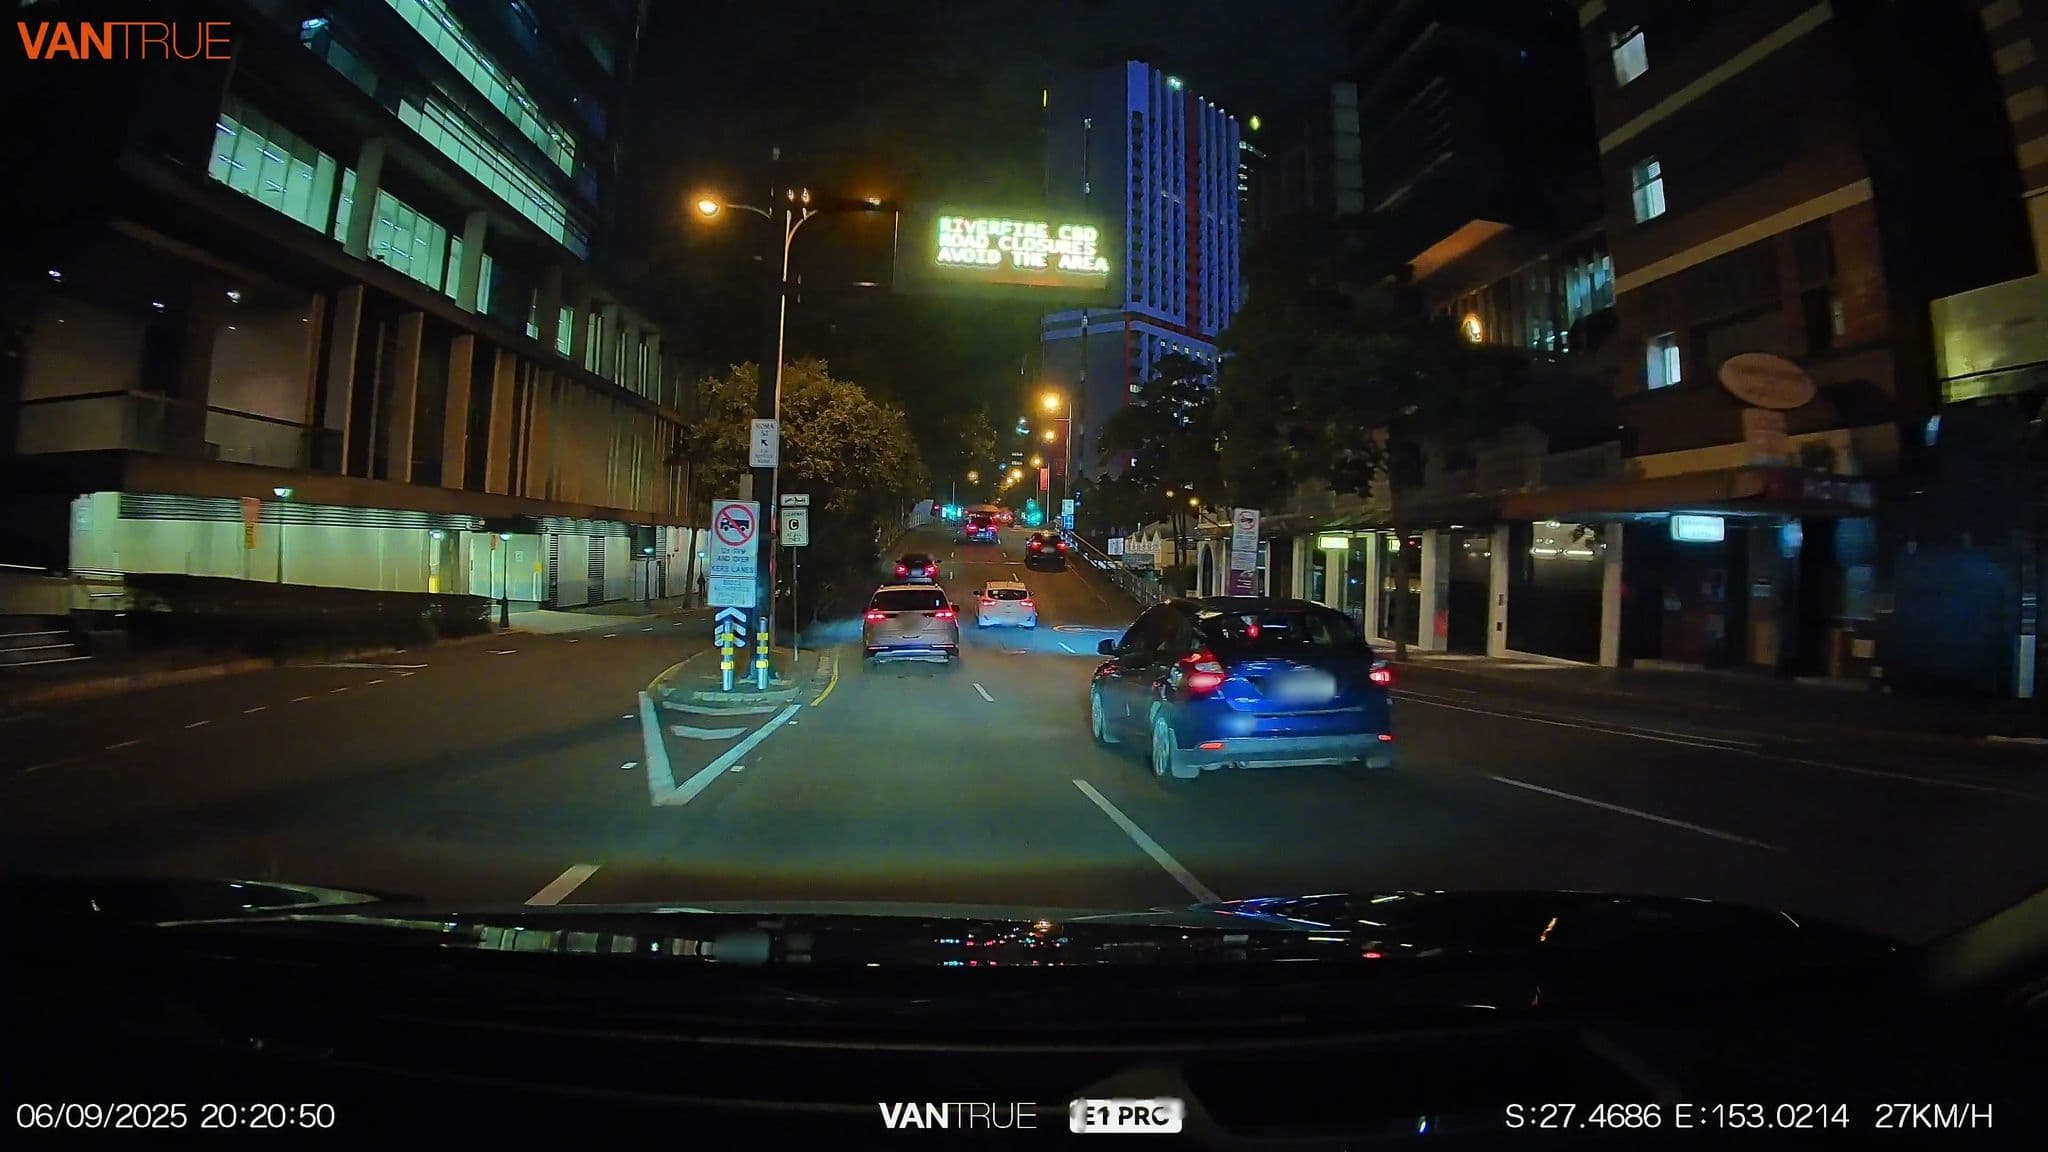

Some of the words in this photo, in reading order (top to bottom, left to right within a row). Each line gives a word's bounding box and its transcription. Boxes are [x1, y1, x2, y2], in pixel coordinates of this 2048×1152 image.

[939, 216, 1048, 238] RIVERFIRE
[1058, 224, 1098, 242] CBD
[939, 232, 989, 249] ROAD
[998, 235, 1097, 256] CLOSURES
[938, 247, 1001, 264] AVOID
[1011, 250, 1048, 267] THE
[1058, 254, 1110, 272] AREA
